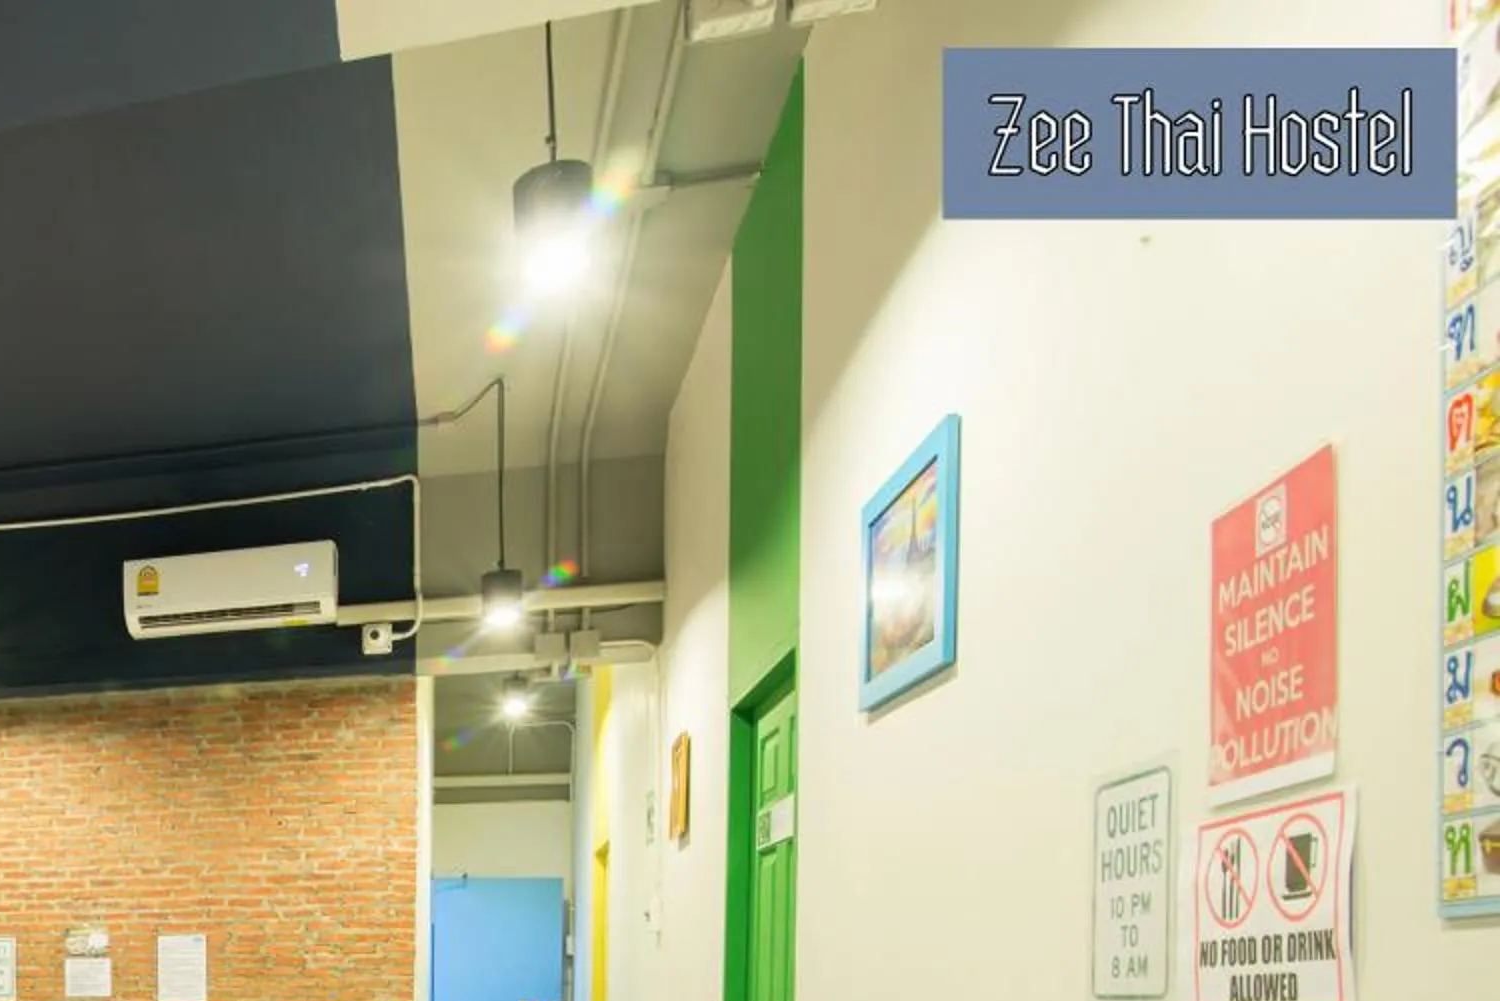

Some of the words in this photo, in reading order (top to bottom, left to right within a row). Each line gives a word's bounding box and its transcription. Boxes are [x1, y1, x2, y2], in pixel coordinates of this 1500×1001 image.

[1217, 524, 1330, 614] MAINTAIN
[1224, 584, 1316, 657] SILENCE
[1260, 646, 1280, 667] NO
[1234, 663, 1306, 722] NOISE
[1106, 792, 1159, 839] QUIET
[1100, 837, 1163, 883] HOURS
[1109, 893, 1125, 919] 10
[1131, 890, 1152, 918] PM
[1120, 923, 1139, 949] TO
[1199, 939, 1219, 969] NO
[1220, 935, 1258, 967] FOOD
[1261, 933, 1283, 965] OR
[1287, 927, 1337, 963] DRINK
[1110, 955, 1121, 980] 8
[1125, 954, 1149, 980] AM
